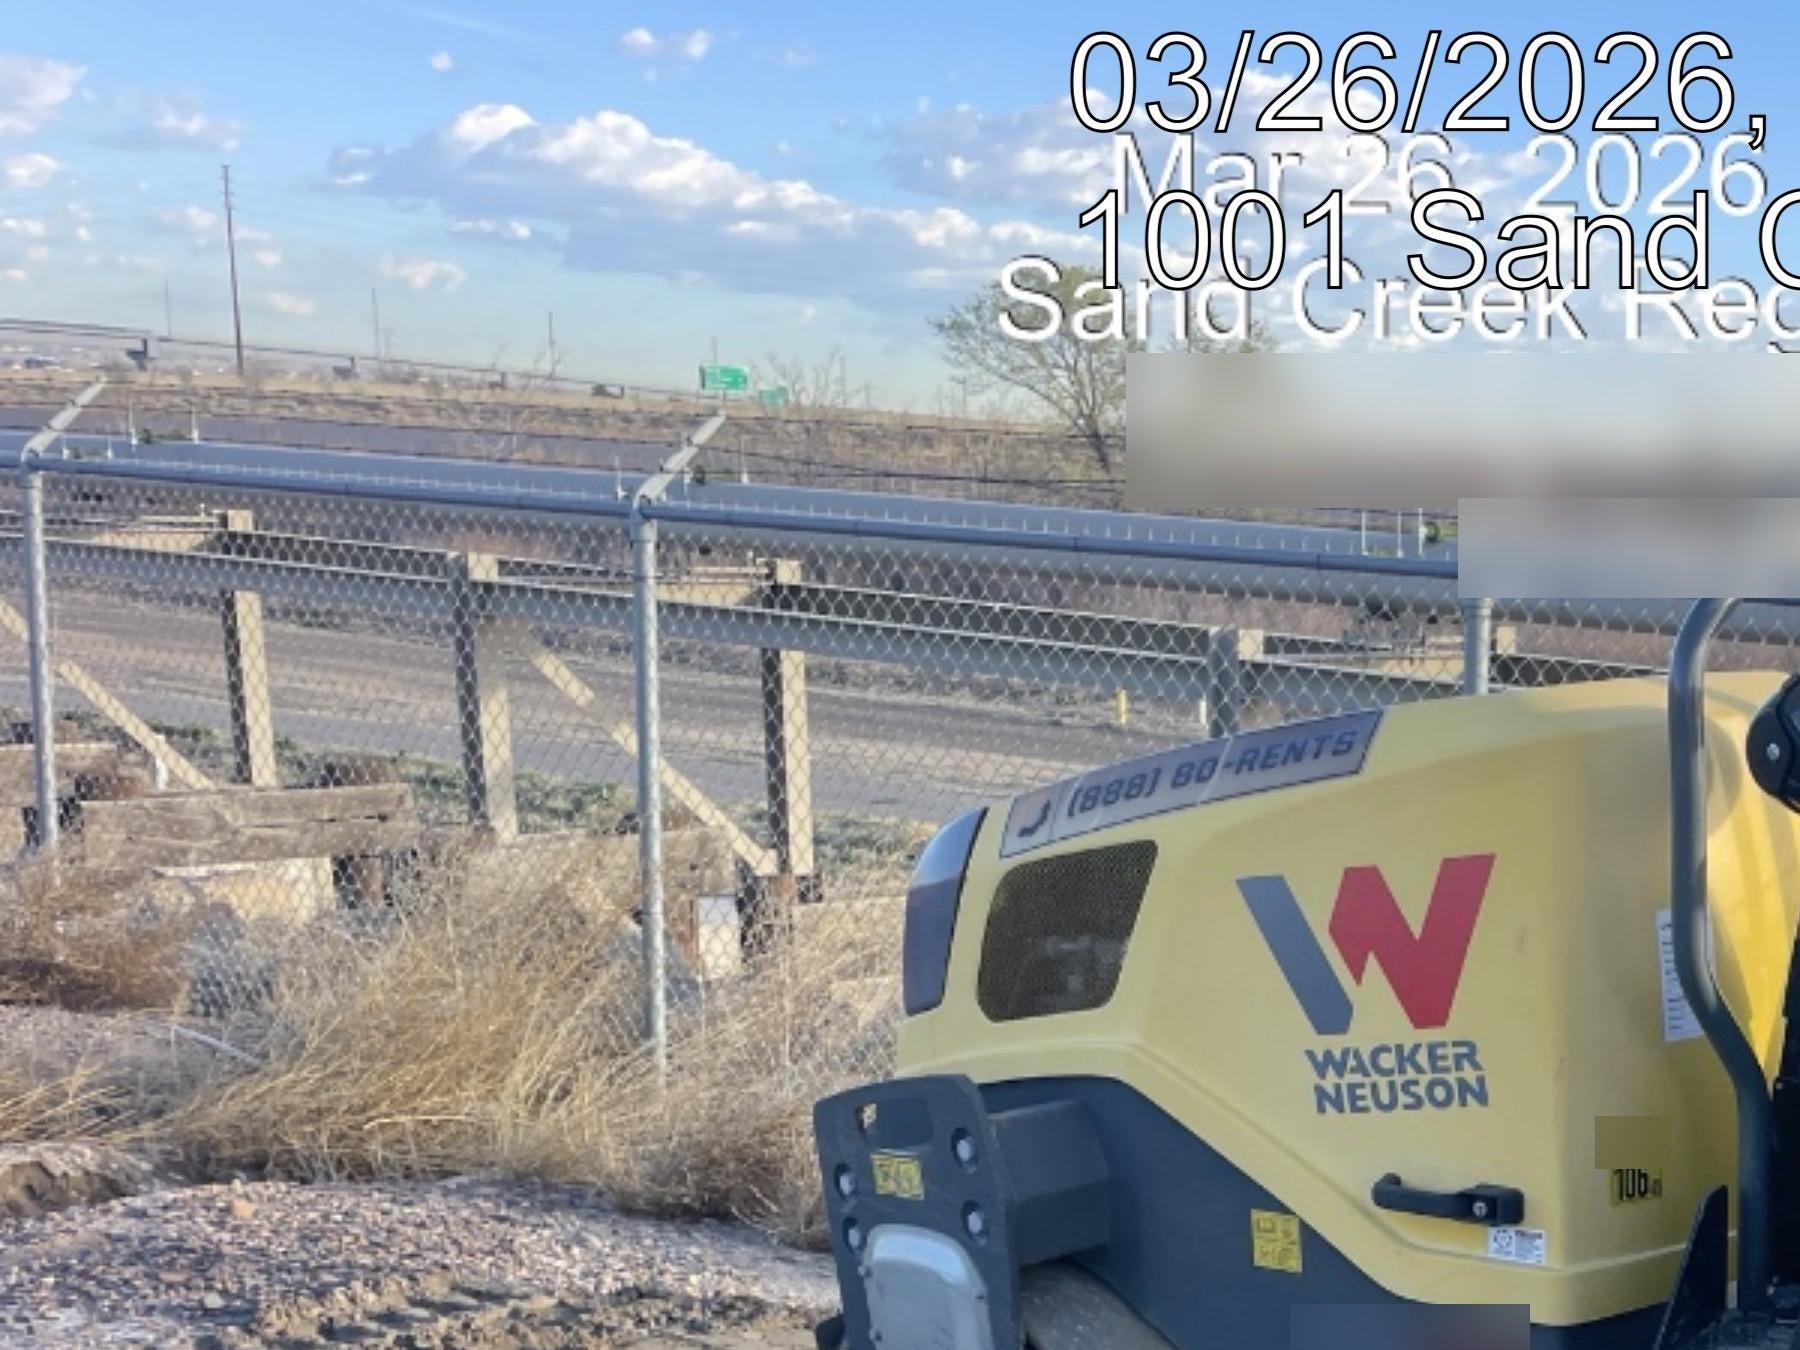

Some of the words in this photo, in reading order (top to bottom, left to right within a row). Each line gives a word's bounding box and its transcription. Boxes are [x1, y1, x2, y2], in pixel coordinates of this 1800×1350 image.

[1067, 768, 1159, 818] (888)
[1170, 731, 1357, 790] 80-RENTS
[1304, 1040, 1485, 1080] WACKER
[1313, 1074, 1489, 1115] NEUSON
